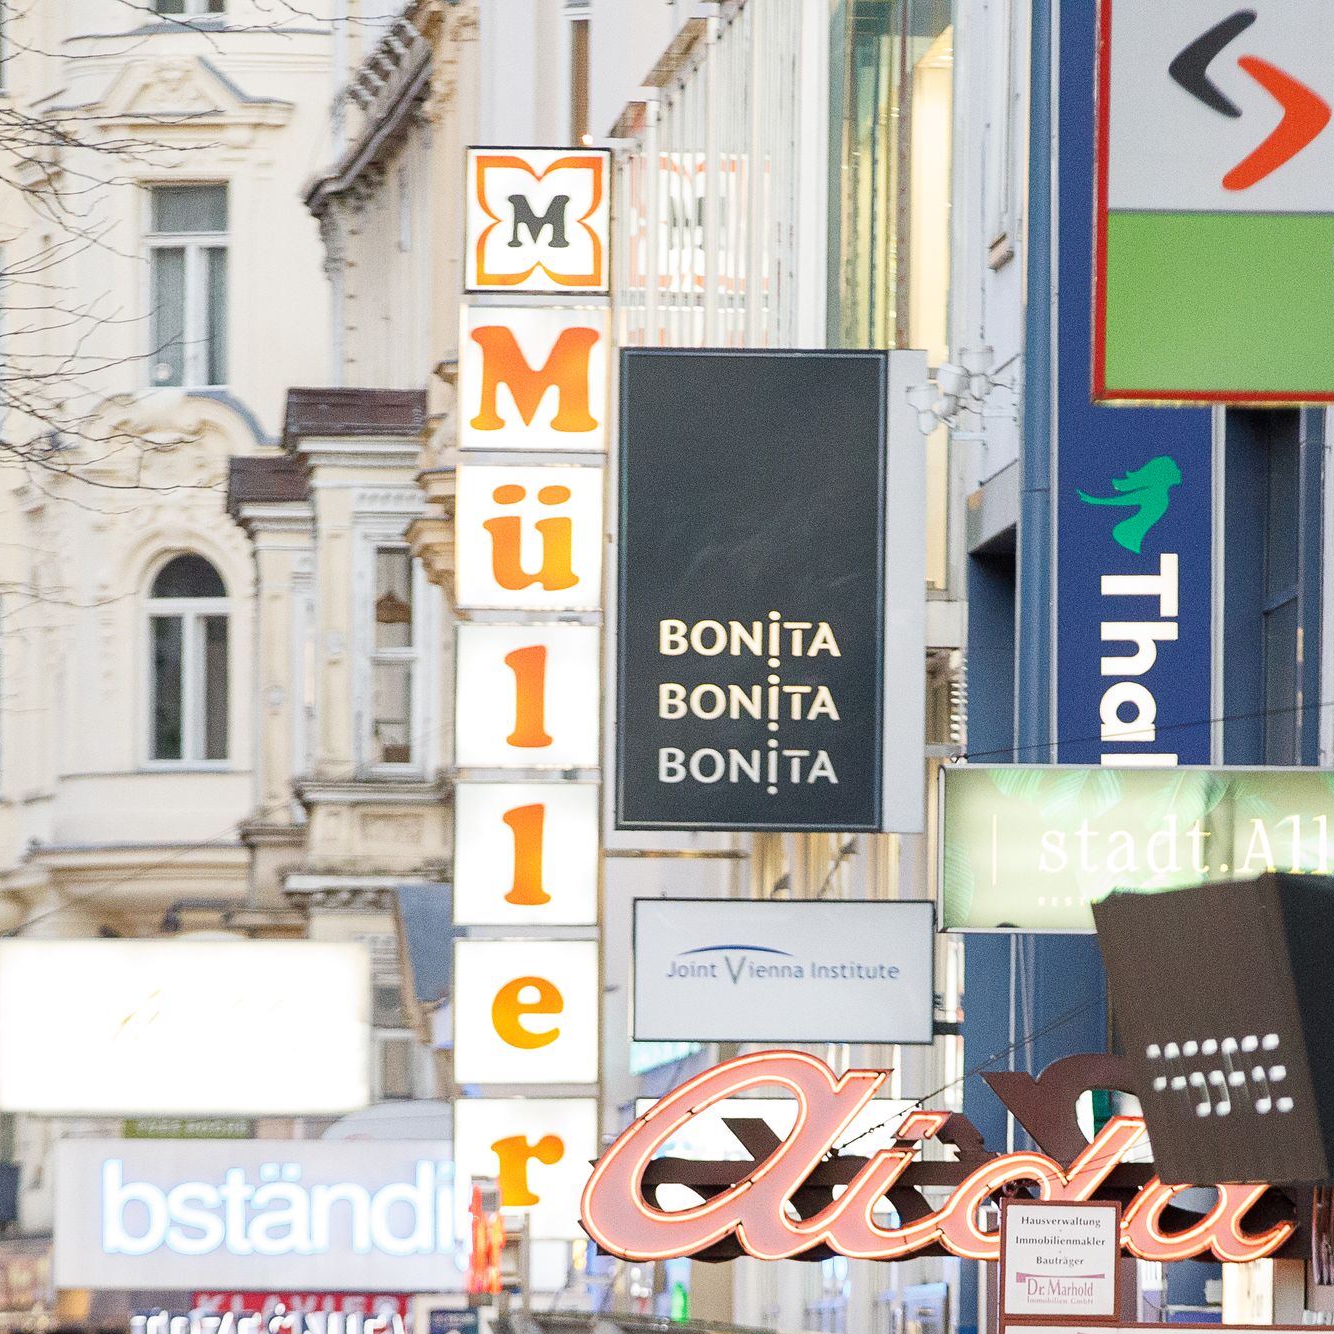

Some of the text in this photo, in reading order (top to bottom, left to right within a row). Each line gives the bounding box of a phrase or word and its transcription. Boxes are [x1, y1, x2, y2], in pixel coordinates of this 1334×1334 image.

[666, 955, 900, 985] Joint Vienna Institute
[102, 1159, 469, 1271] bständi
[1021, 1216, 1101, 1228] Hausverwaltung
[1015, 1236, 1105, 1246] Immobilienmakler
[1036, 1256, 1084, 1267] Bauträger
[1028, 1278, 1094, 1297] Dr. Marhold
